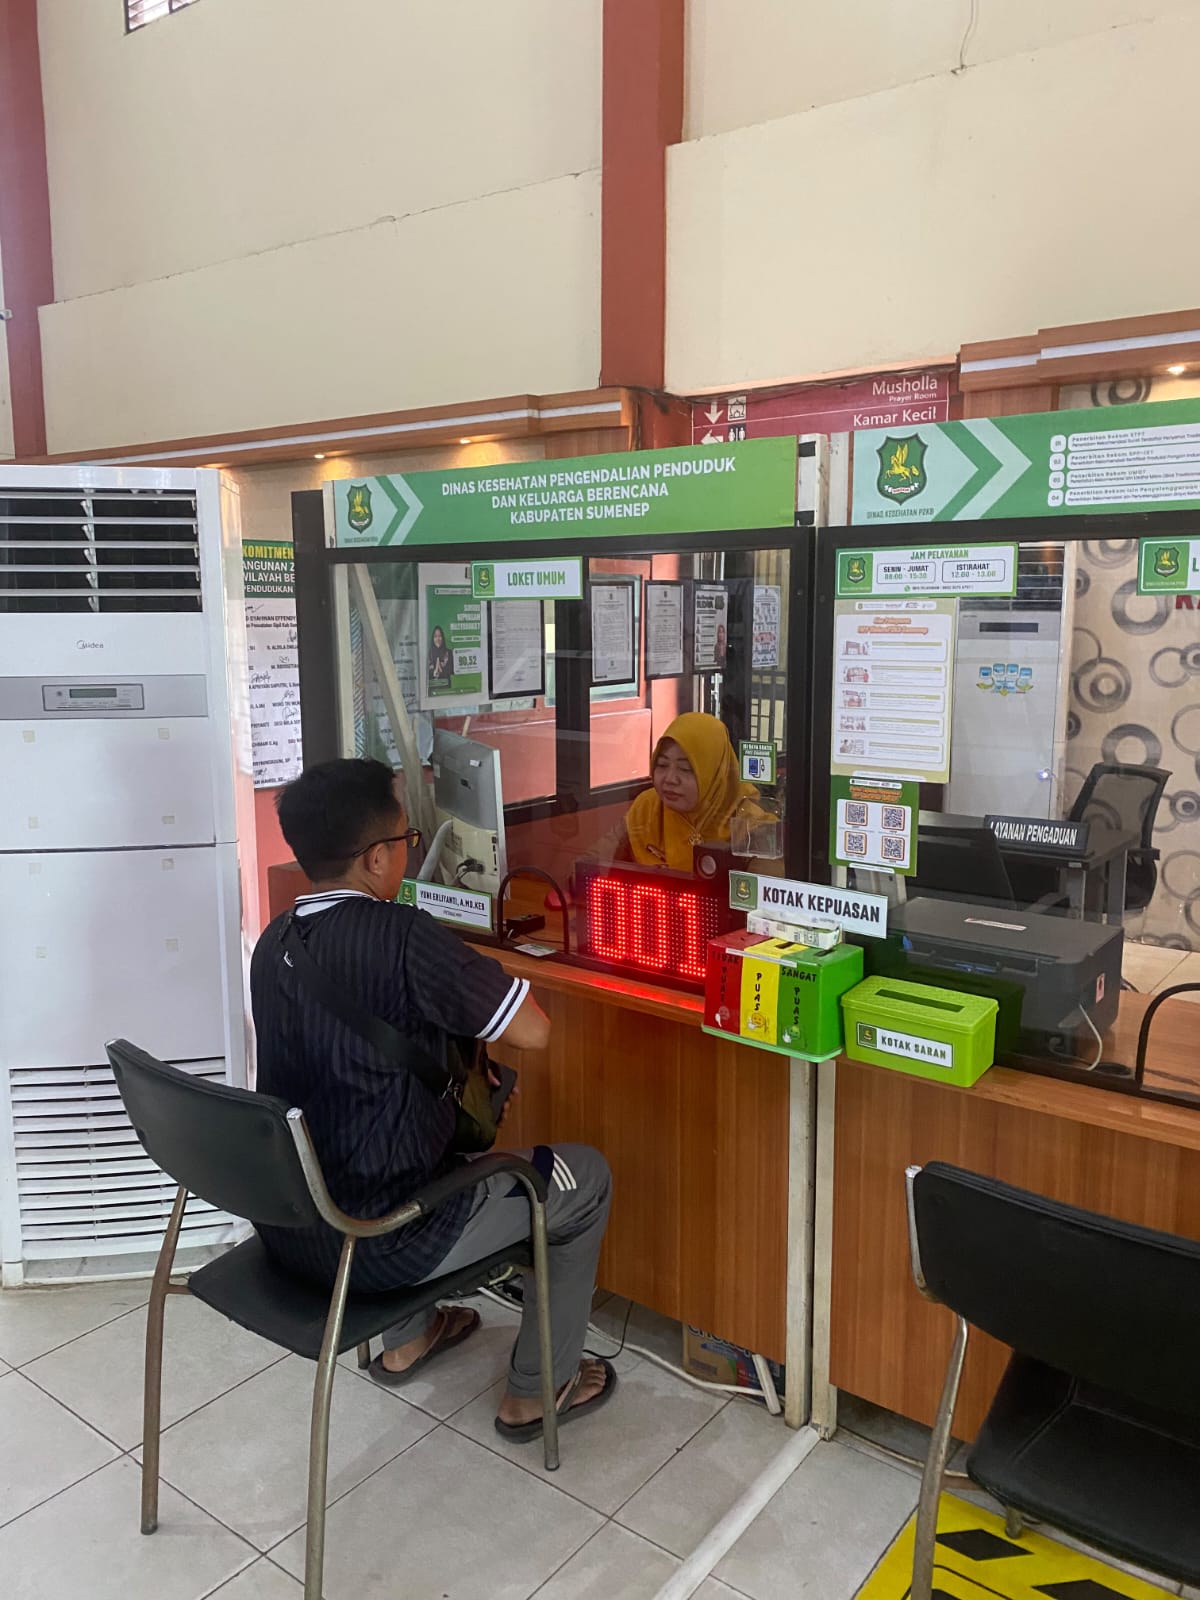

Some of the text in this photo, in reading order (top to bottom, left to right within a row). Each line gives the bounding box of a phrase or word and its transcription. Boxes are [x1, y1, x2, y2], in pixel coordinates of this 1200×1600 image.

[872, 376, 938, 396] Musholla
[889, 392, 937, 403] Prayer Room
[853, 407, 937, 426] Kamar Kecil
[442, 457, 736, 496] DINAS KESEHATAN PENGENDALIAN PENDUDUK
[492, 483, 669, 508] DAN KELUARGA BERENCANA
[510, 502, 650, 524] KABUPATEN SUMENEP
[911, 549, 969, 560] JAM PELAYANAN
[956, 562, 990, 571] ISTIRAHAT
[507, 571, 566, 586] LOKET UMUM
[244, 584, 294, 593] ENDUDUKAN
[76, 640, 104, 650] Midea
[1026, 825, 1078, 846] PENGADUAN
[420, 890, 432, 900] YUNI
[763, 886, 880, 923] KOTAK KEPUASAN
[781, 967, 817, 983] SANGAT
[754, 972, 763, 1011] PUAS
[881, 1035, 946, 1060] KOTAK SARAN
